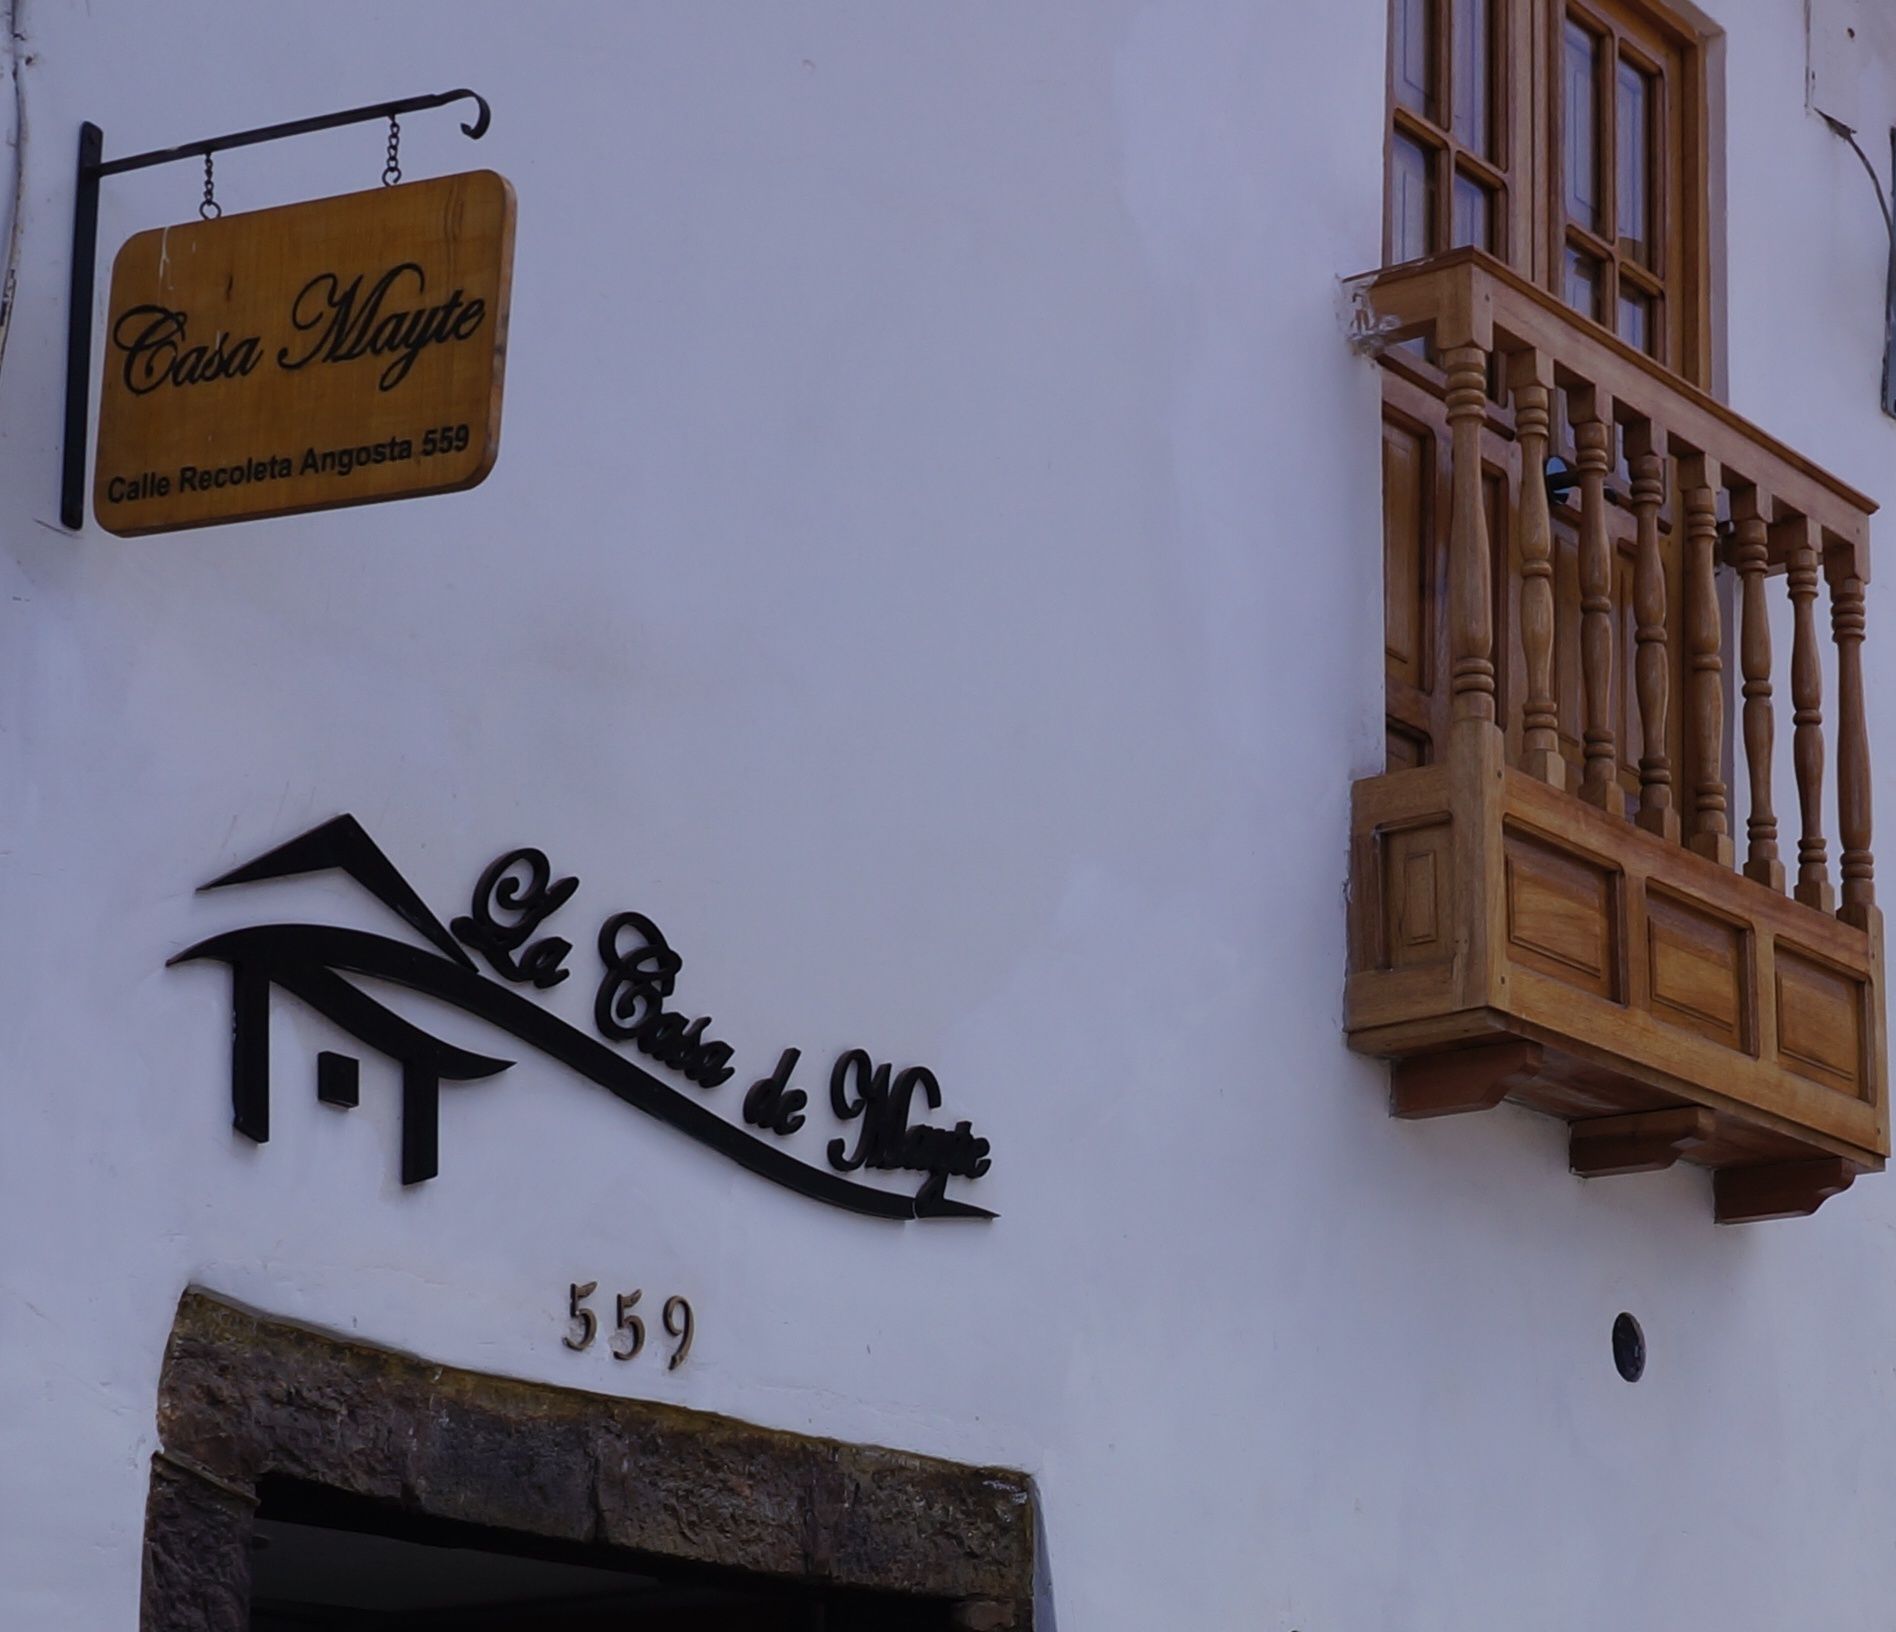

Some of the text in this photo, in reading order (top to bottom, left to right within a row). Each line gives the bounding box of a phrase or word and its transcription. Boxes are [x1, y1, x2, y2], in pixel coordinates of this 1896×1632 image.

[114, 262, 486, 396] Casa Mayte
[108, 424, 469, 504] Calle Recoleta Angosta 559
[450, 847, 992, 1200] La Casa de Mayte
[562, 1280, 696, 1370] 559
